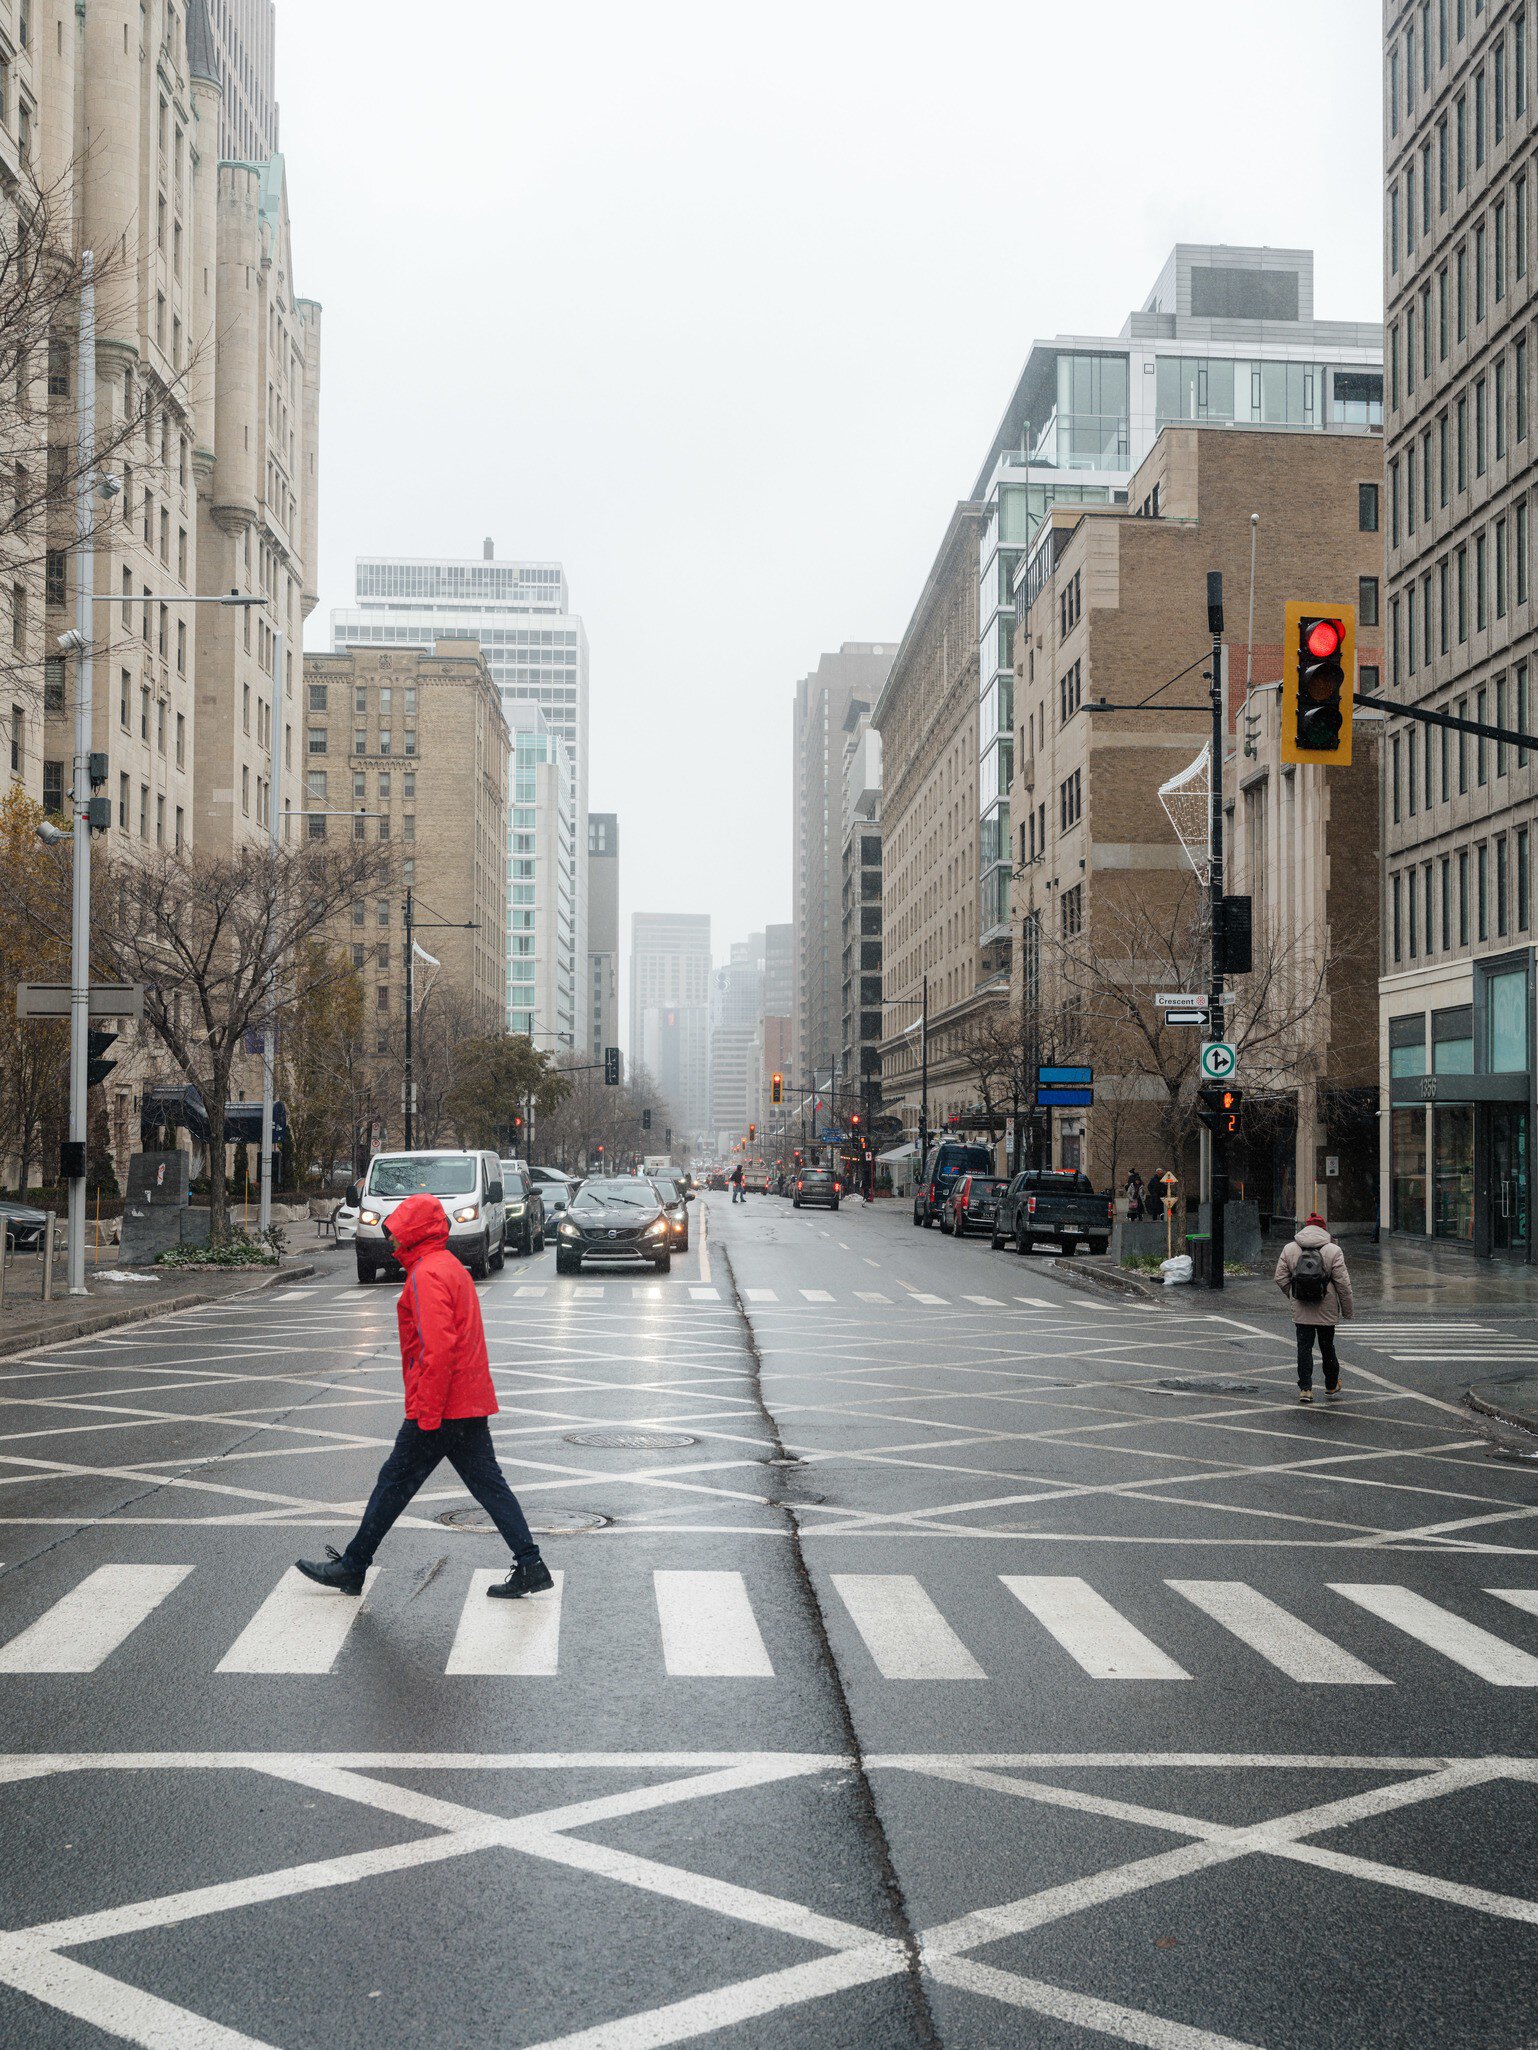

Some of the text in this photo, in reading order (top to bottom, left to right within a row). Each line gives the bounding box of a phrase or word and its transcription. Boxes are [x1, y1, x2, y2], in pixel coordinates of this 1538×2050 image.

[1158, 997, 1194, 1005] Crescent
[1419, 1077, 1437, 1098] 1356
[1228, 1115, 1236, 1131] 2
